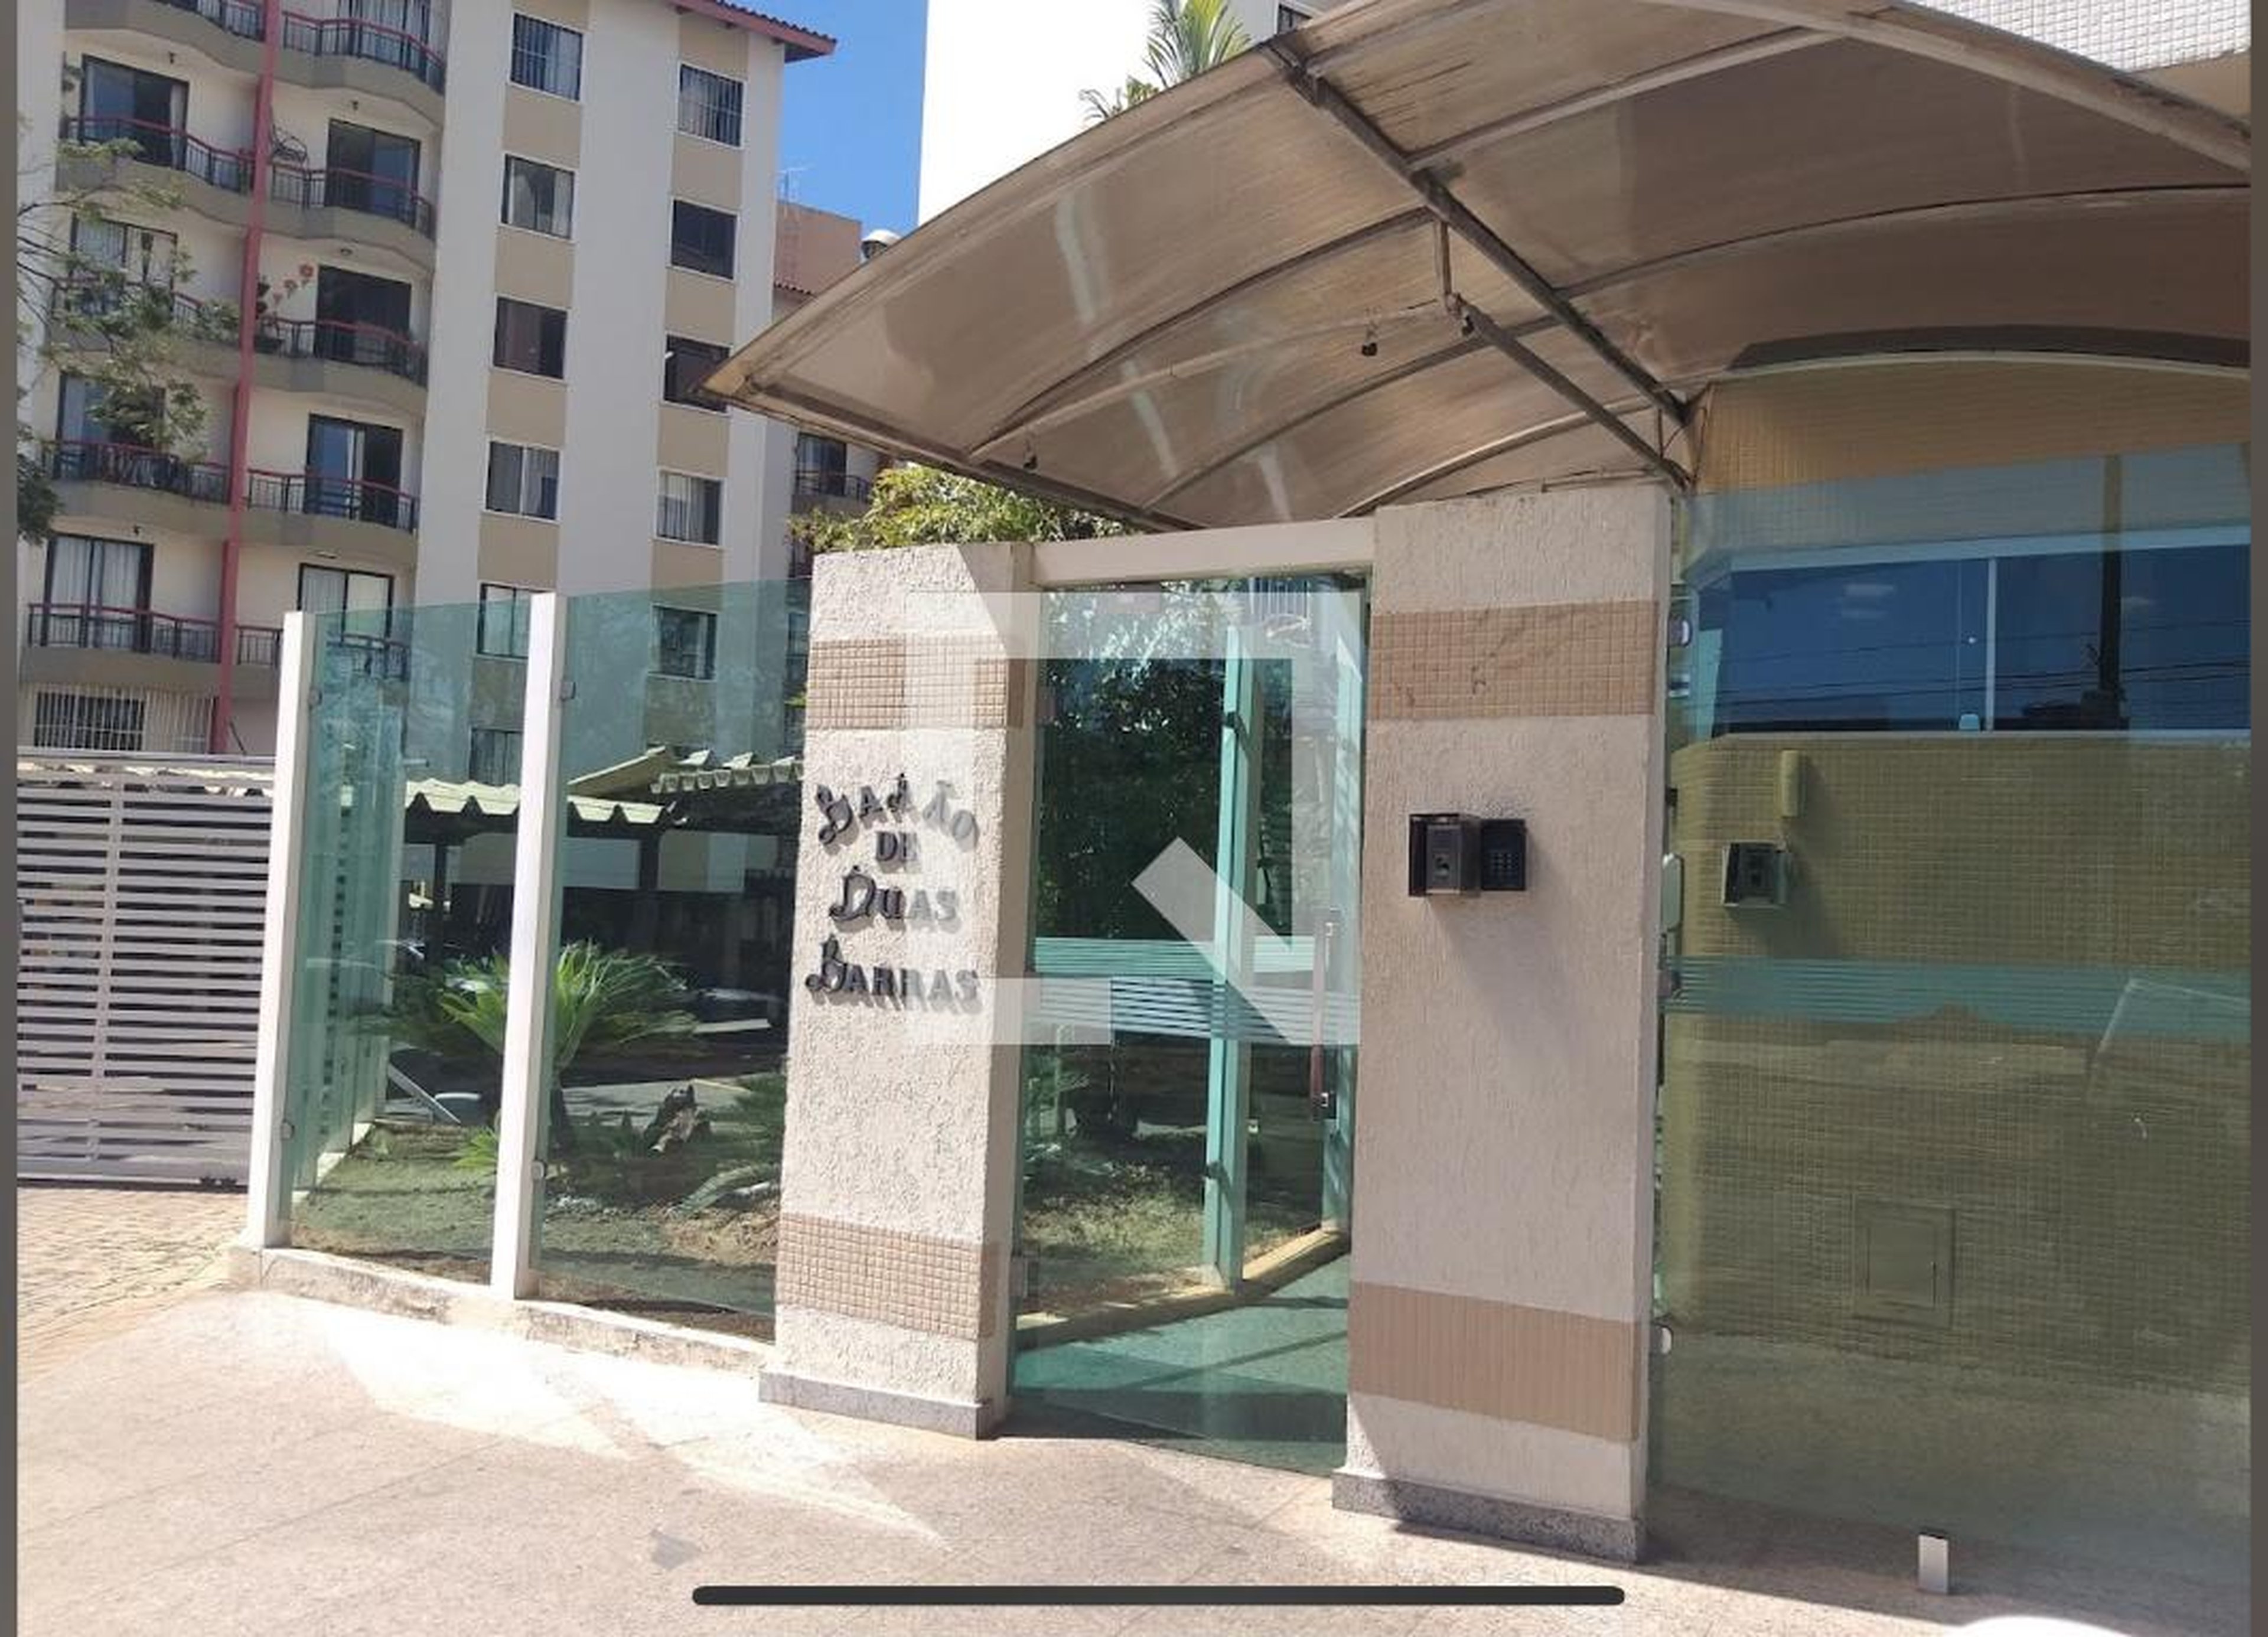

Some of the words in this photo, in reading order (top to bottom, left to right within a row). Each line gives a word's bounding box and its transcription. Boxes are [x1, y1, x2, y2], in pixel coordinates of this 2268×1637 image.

[876, 831, 919, 862] DE
[829, 865, 958, 922] DUAS
[804, 933, 980, 999] BARRAS
